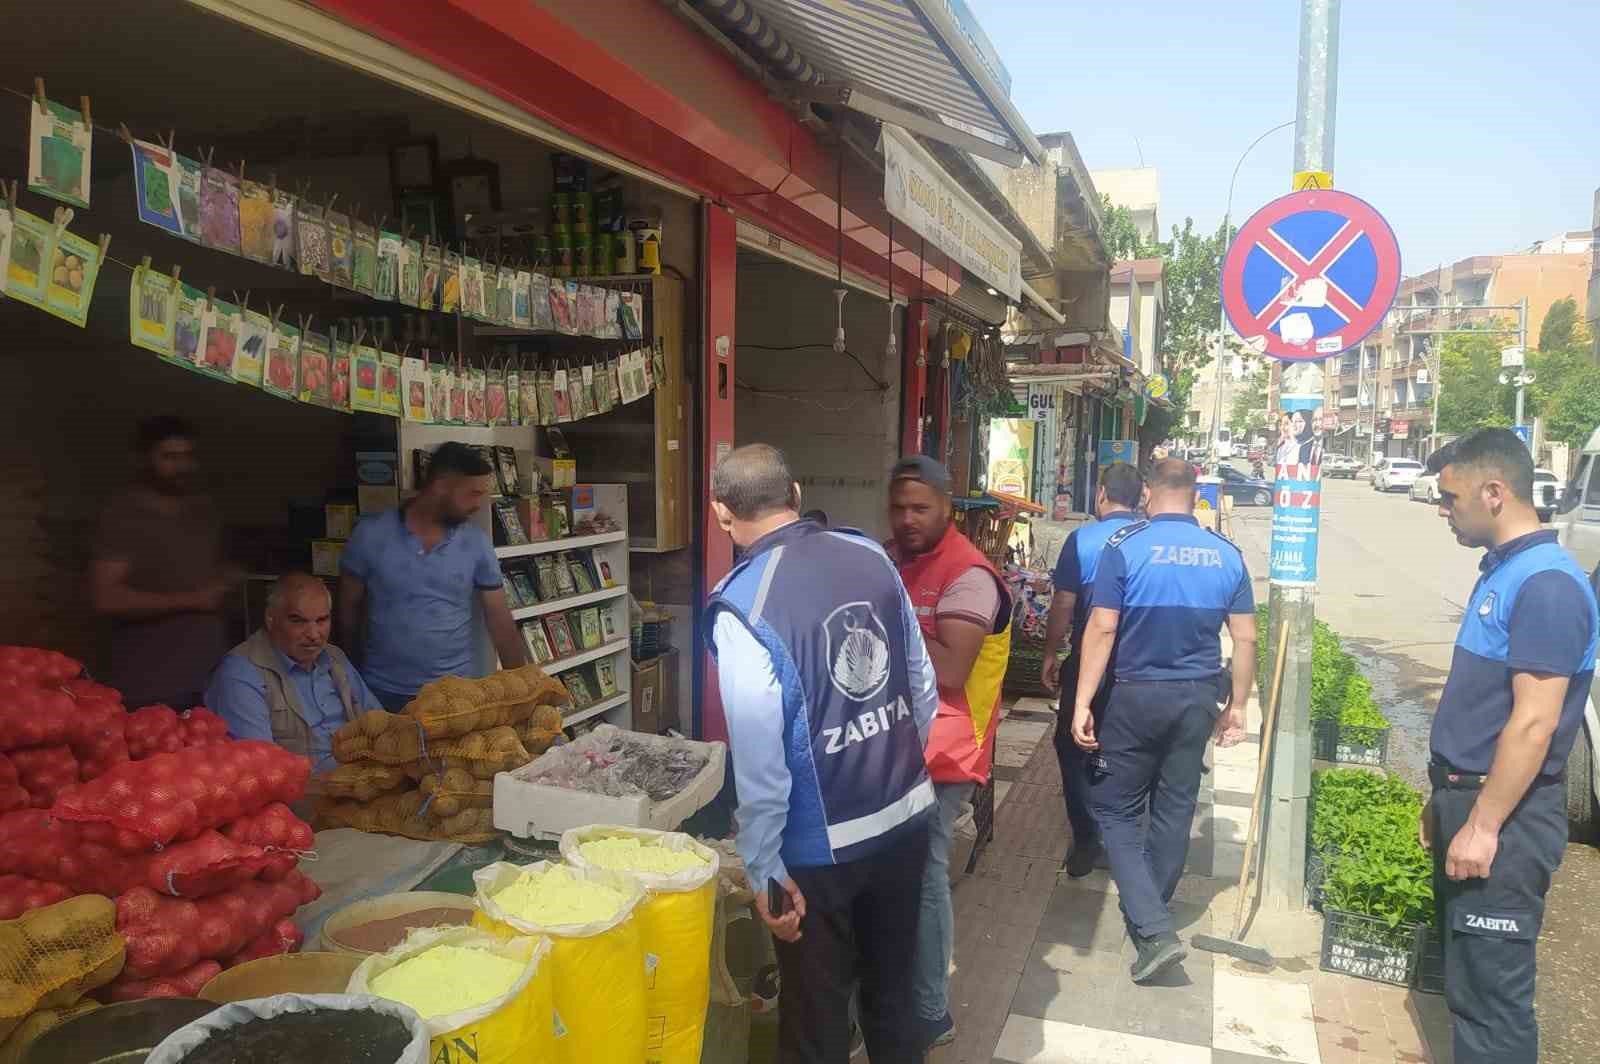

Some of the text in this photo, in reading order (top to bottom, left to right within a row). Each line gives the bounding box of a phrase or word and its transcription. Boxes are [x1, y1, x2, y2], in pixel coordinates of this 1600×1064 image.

[1150, 544, 1223, 569] ZABITA
[823, 695, 911, 754] ZABITA
[1466, 914, 1519, 932] ZABITA
